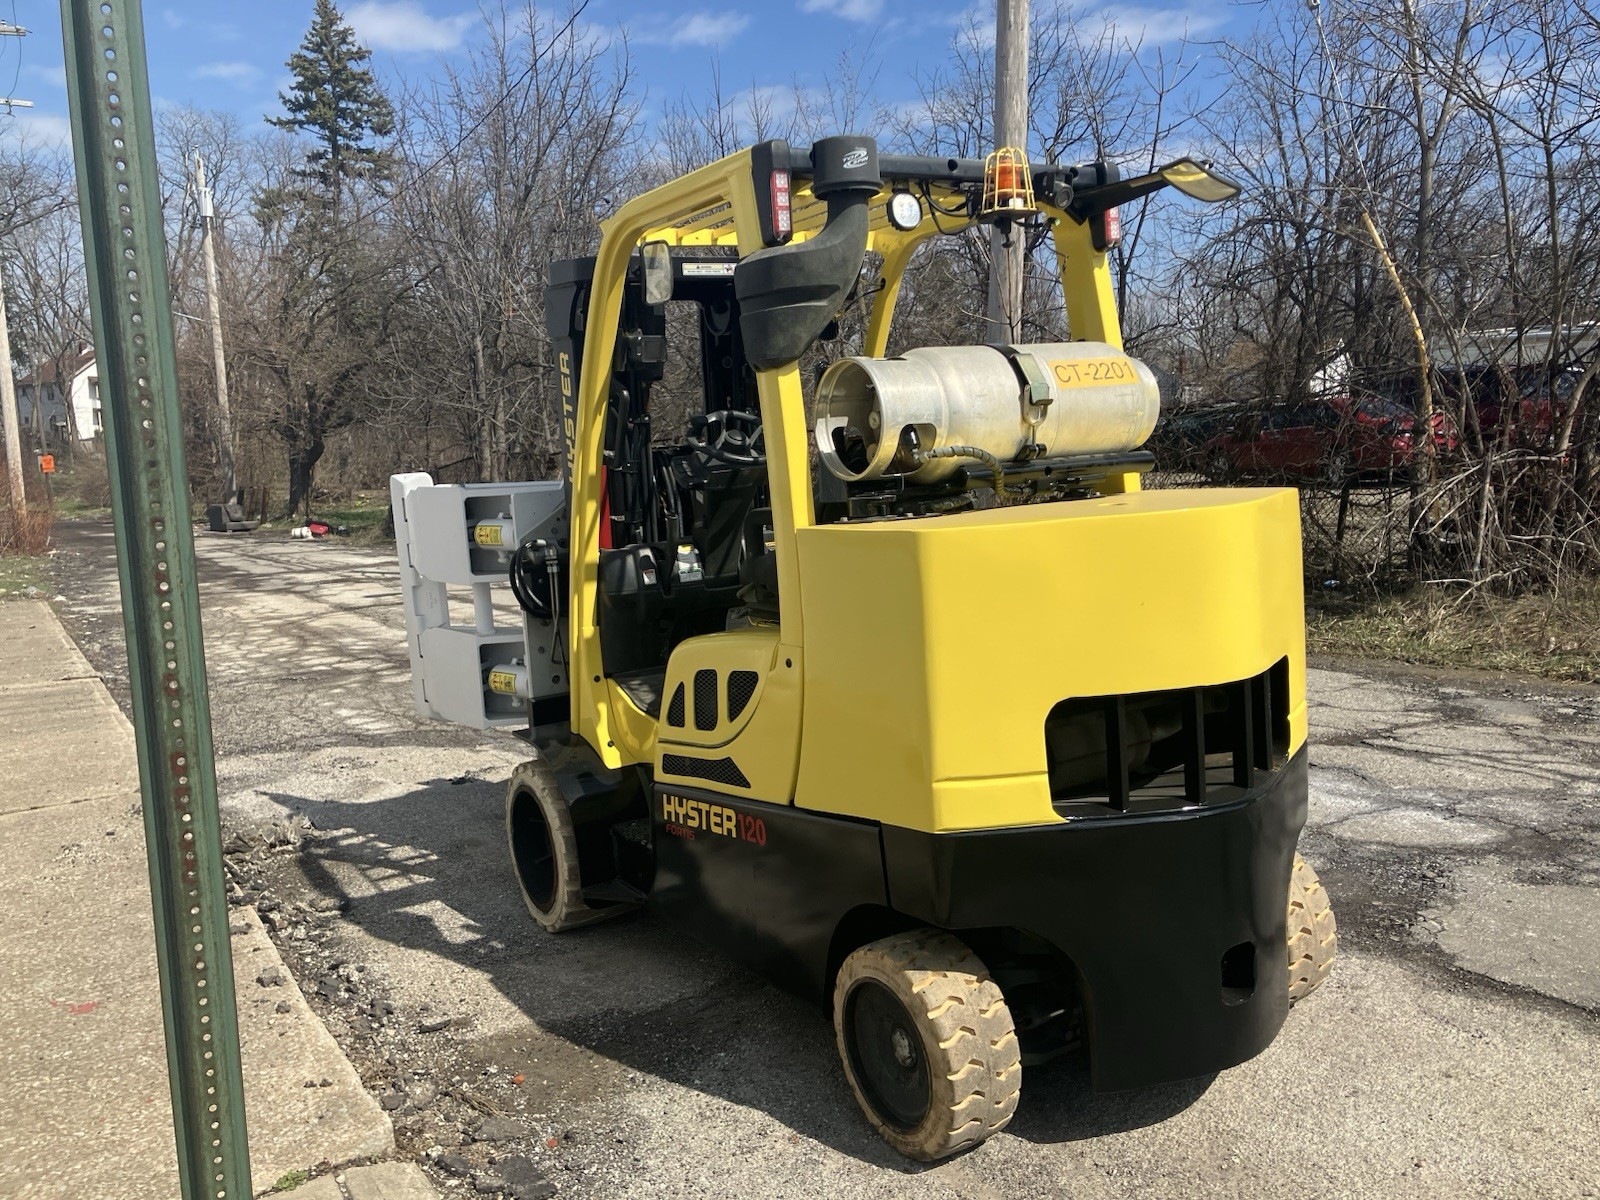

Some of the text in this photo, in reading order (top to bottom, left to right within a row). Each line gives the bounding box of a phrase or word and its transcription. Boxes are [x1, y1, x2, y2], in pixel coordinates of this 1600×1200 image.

[1054, 361, 1134, 383] CT-2201
[662, 793, 767, 846] HYSTER 120
[665, 823, 696, 841] FORTIS
